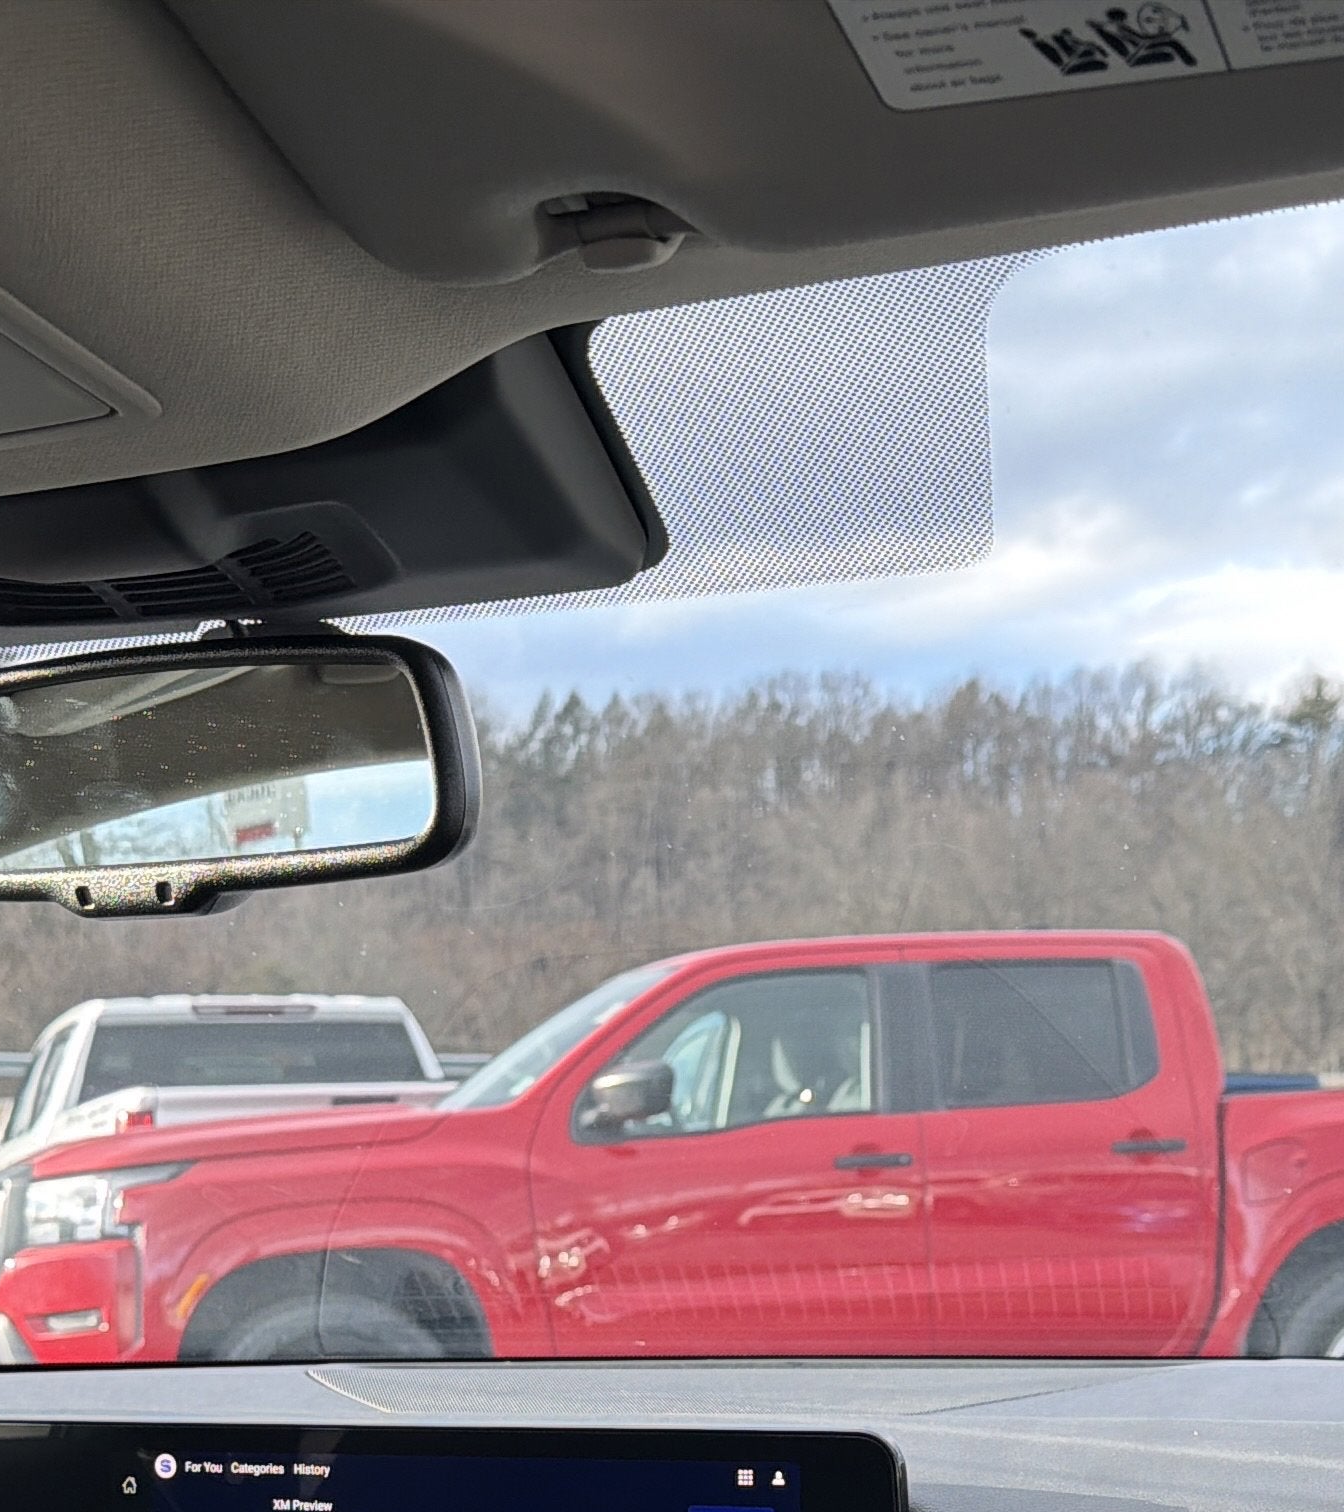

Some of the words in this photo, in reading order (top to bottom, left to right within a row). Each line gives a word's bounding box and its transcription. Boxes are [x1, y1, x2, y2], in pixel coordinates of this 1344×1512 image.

[184, 1462, 202, 1473] For
[204, 1462, 223, 1474] You
[230, 1462, 285, 1476] Categories
[293, 1464, 330, 1478] History
[272, 1500, 290, 1511] XM
[292, 1500, 333, 1512] Preview
